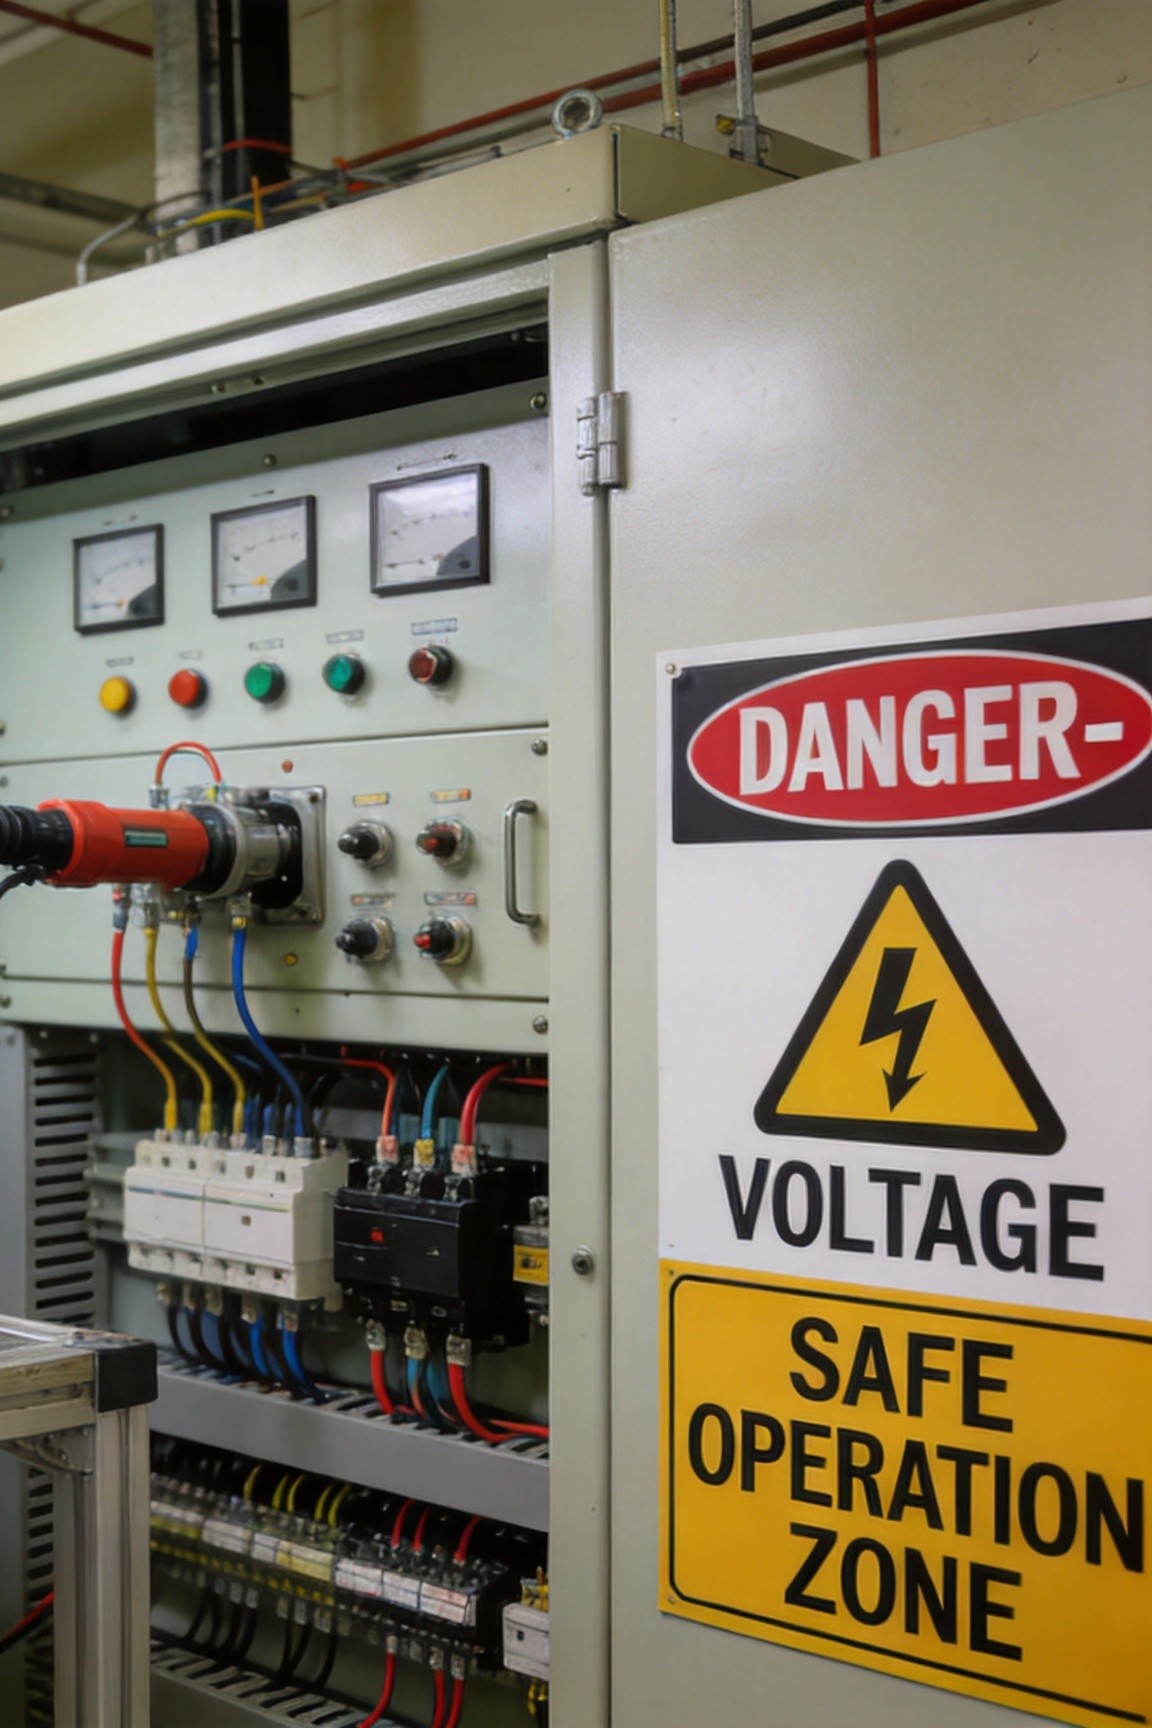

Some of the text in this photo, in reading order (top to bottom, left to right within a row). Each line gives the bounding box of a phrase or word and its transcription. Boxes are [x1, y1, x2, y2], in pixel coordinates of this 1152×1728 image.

[718, 1154, 1105, 1282] VOLTAGE
[788, 1316, 1014, 1433] SAFE
[688, 1402, 1144, 1575] OPERATION
[784, 1521, 1023, 1662] ZONE
